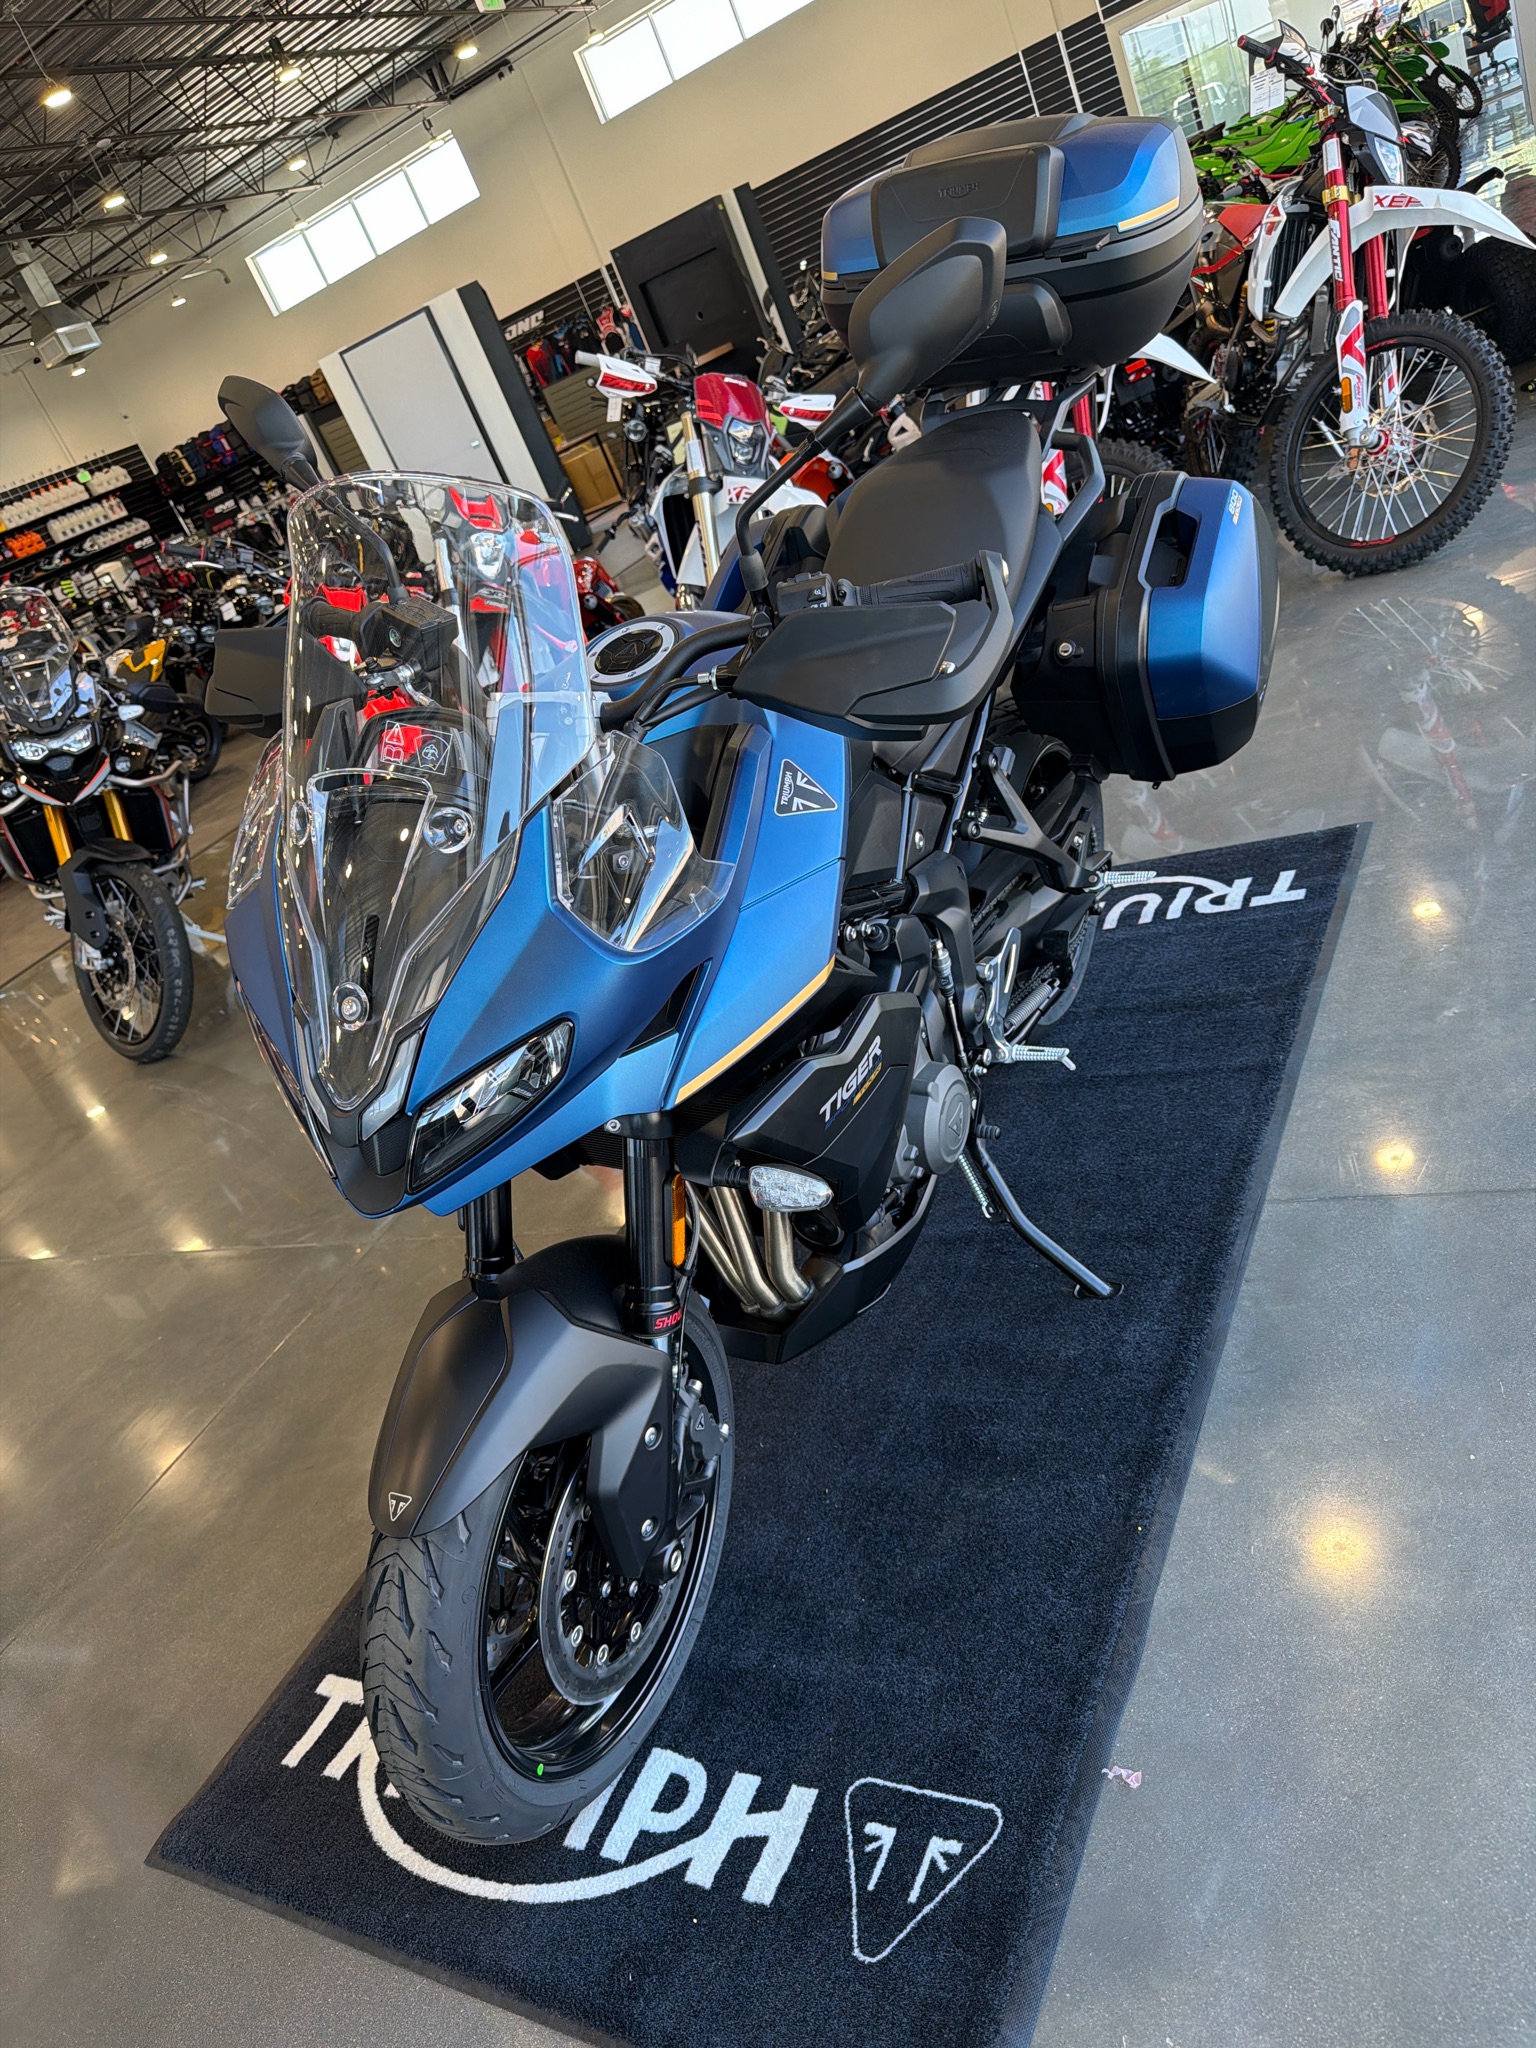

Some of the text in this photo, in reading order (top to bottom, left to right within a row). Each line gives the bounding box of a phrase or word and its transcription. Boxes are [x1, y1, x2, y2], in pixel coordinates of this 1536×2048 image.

[1327, 219, 1344, 282] FANTIC
[781, 770, 794, 805] TRIUMPH
[1099, 869, 1307, 930] TRIU
[819, 1035, 882, 1122] TIGER
